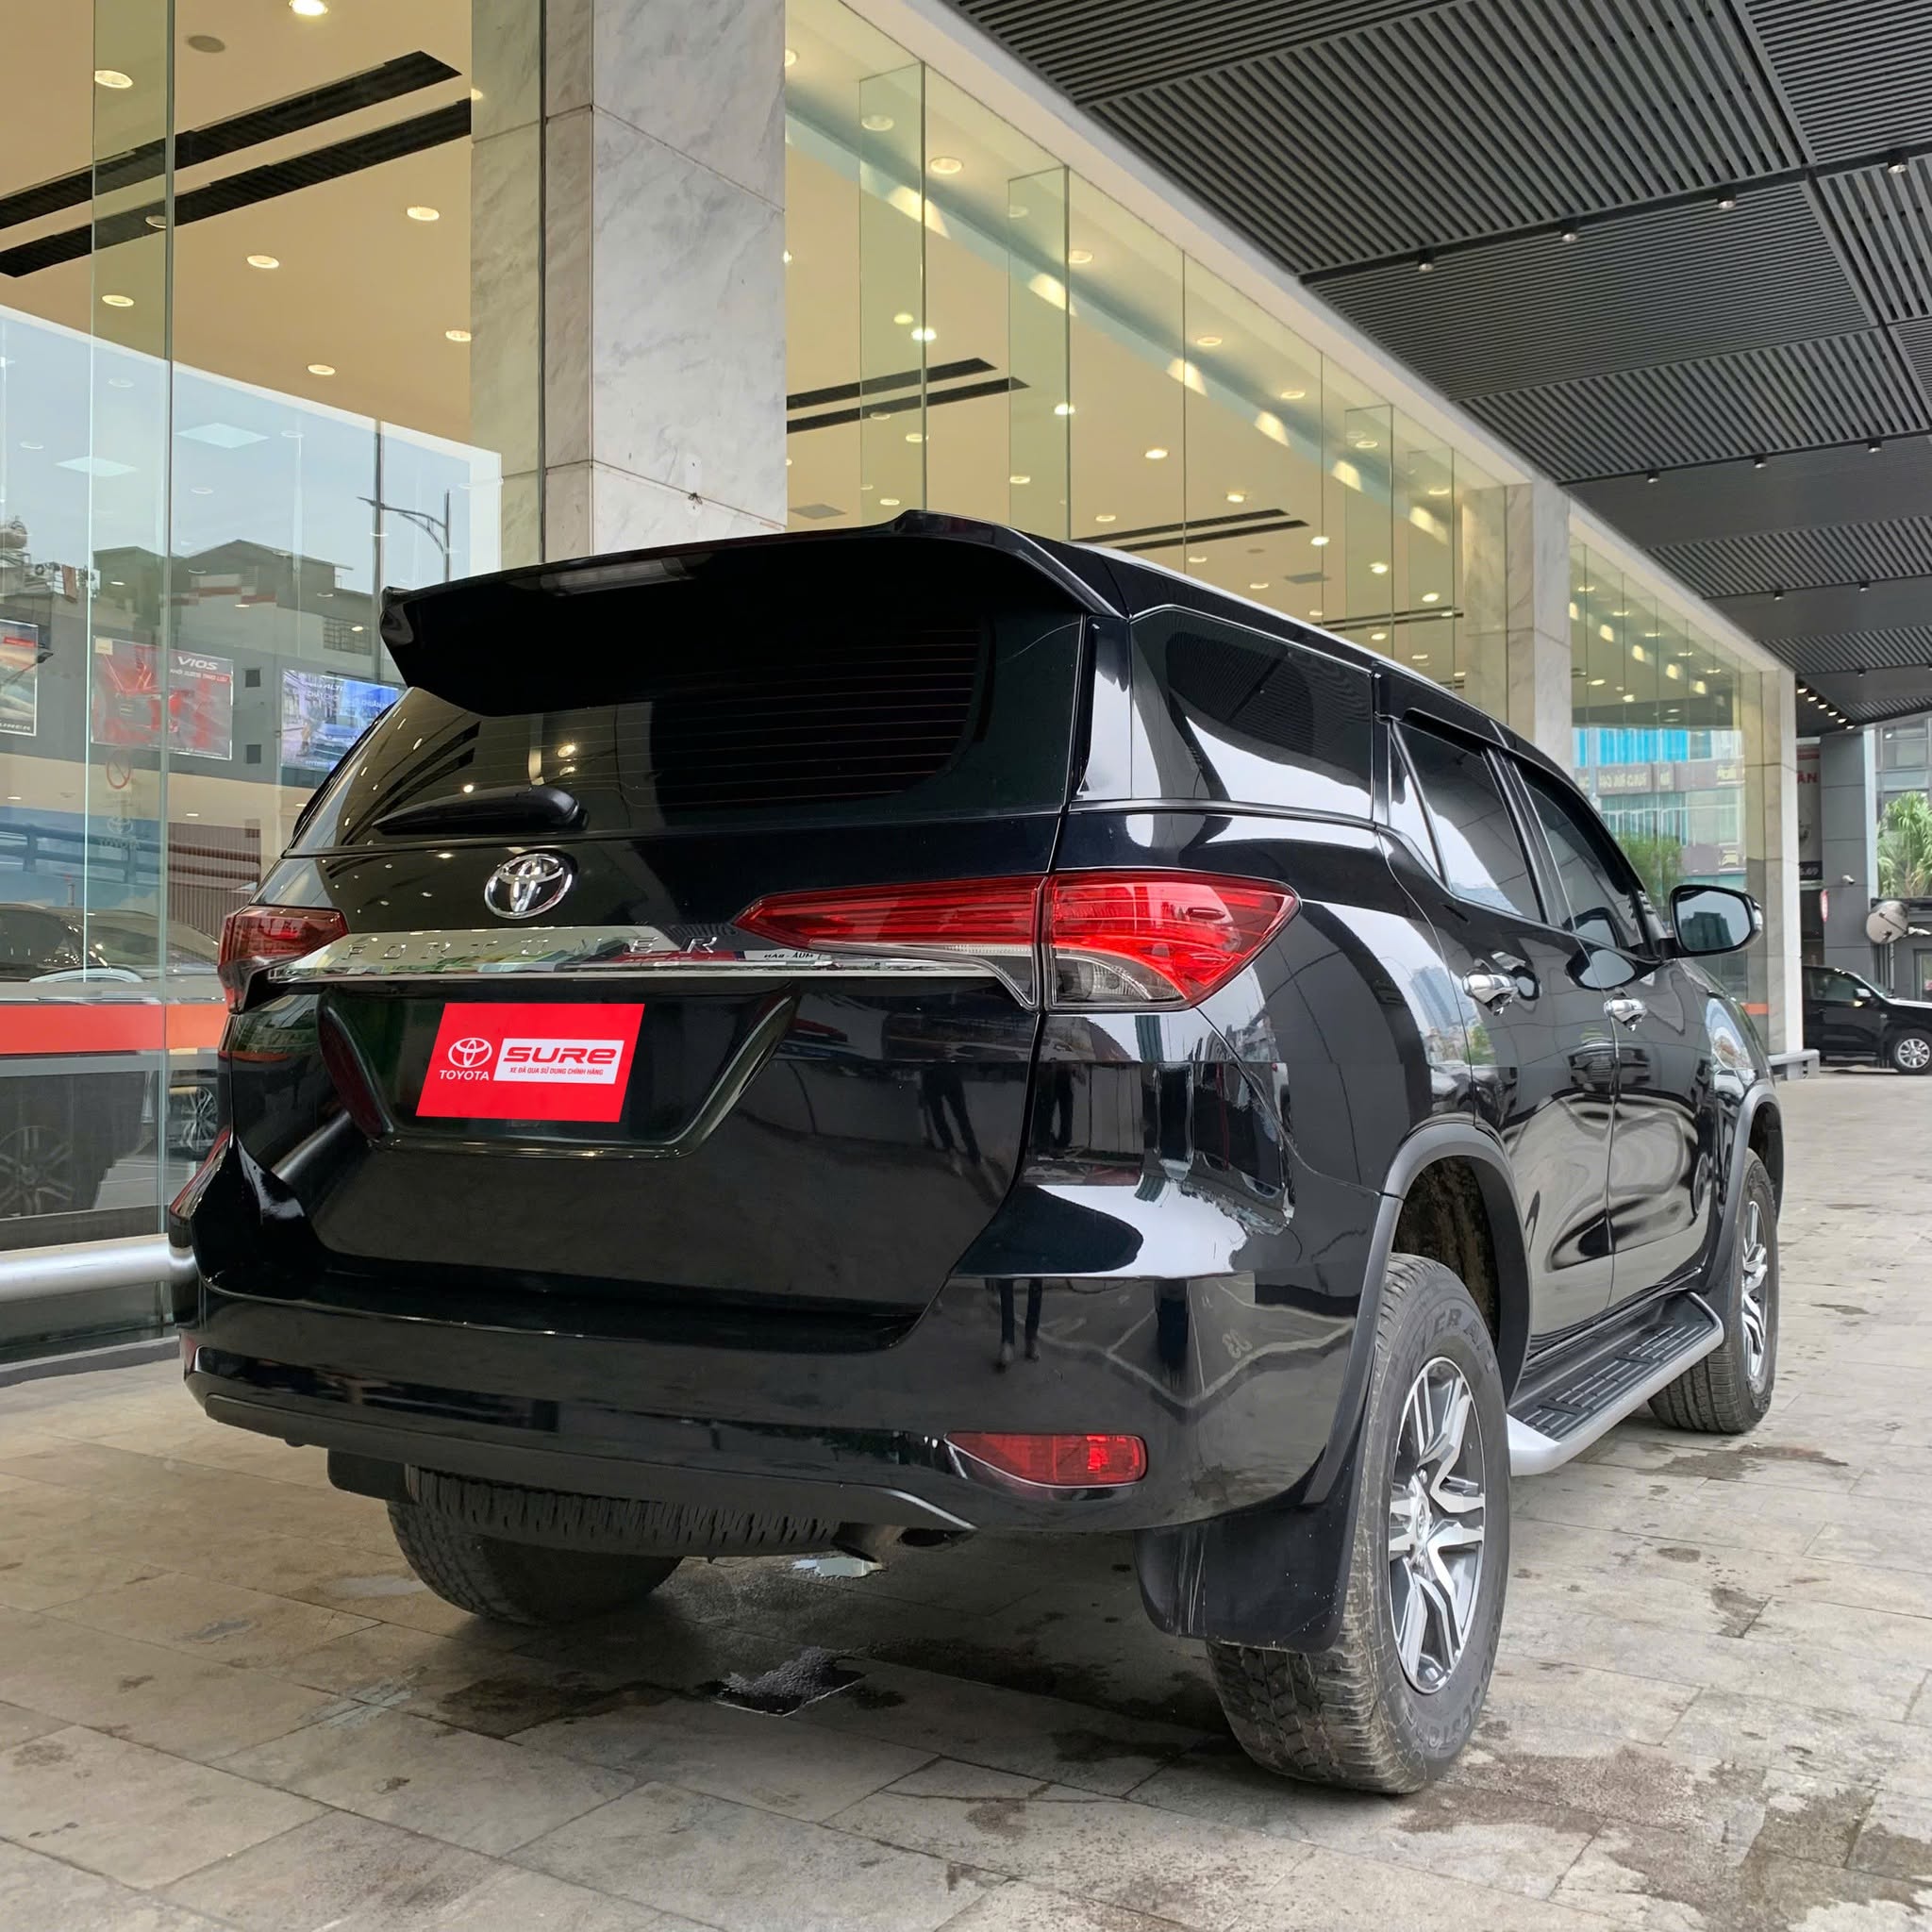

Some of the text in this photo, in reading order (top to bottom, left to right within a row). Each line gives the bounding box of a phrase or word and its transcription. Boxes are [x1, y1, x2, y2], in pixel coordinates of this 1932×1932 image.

[177, 656, 218, 671] VIOS
[341, 936, 718, 960] FORTUNER
[503, 1046, 617, 1064] SURE
[439, 1070, 490, 1081] TOYOTA
